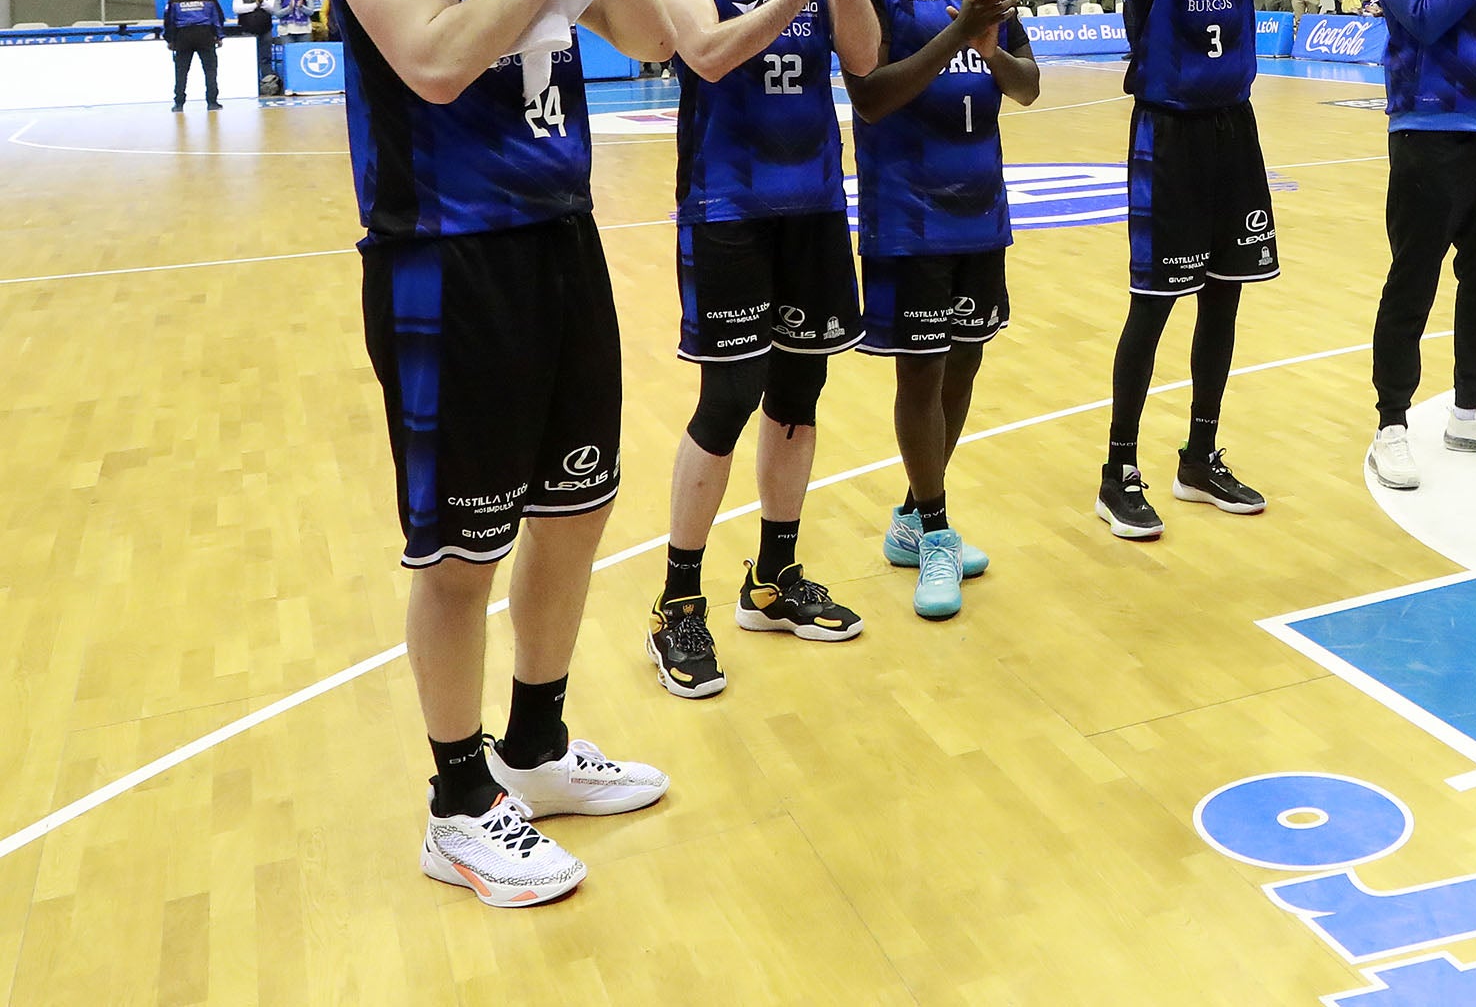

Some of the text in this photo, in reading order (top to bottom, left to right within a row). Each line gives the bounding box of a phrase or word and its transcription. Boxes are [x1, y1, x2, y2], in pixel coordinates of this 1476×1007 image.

[1028, 25, 1074, 42] Diario
[1078, 25, 1097, 40] de
[1256, 18, 1279, 34] LEÓN
[1206, 24, 1223, 59] 3
[763, 54, 803, 95] 22
[524, 85, 567, 139] 24
[963, 95, 973, 133] 1
[1237, 229, 1276, 246] LEXUS
[706, 309, 747, 320] CASTILLA
[904, 310, 940, 319] CASTILLA
[717, 334, 758, 348] GIVOVA
[911, 333, 946, 342] GIVOVA
[544, 469, 609, 492] LEXUS
[448, 495, 501, 508] CASTILLA
[505, 491, 511, 503] Y
[462, 523, 511, 539] GIVOVA
